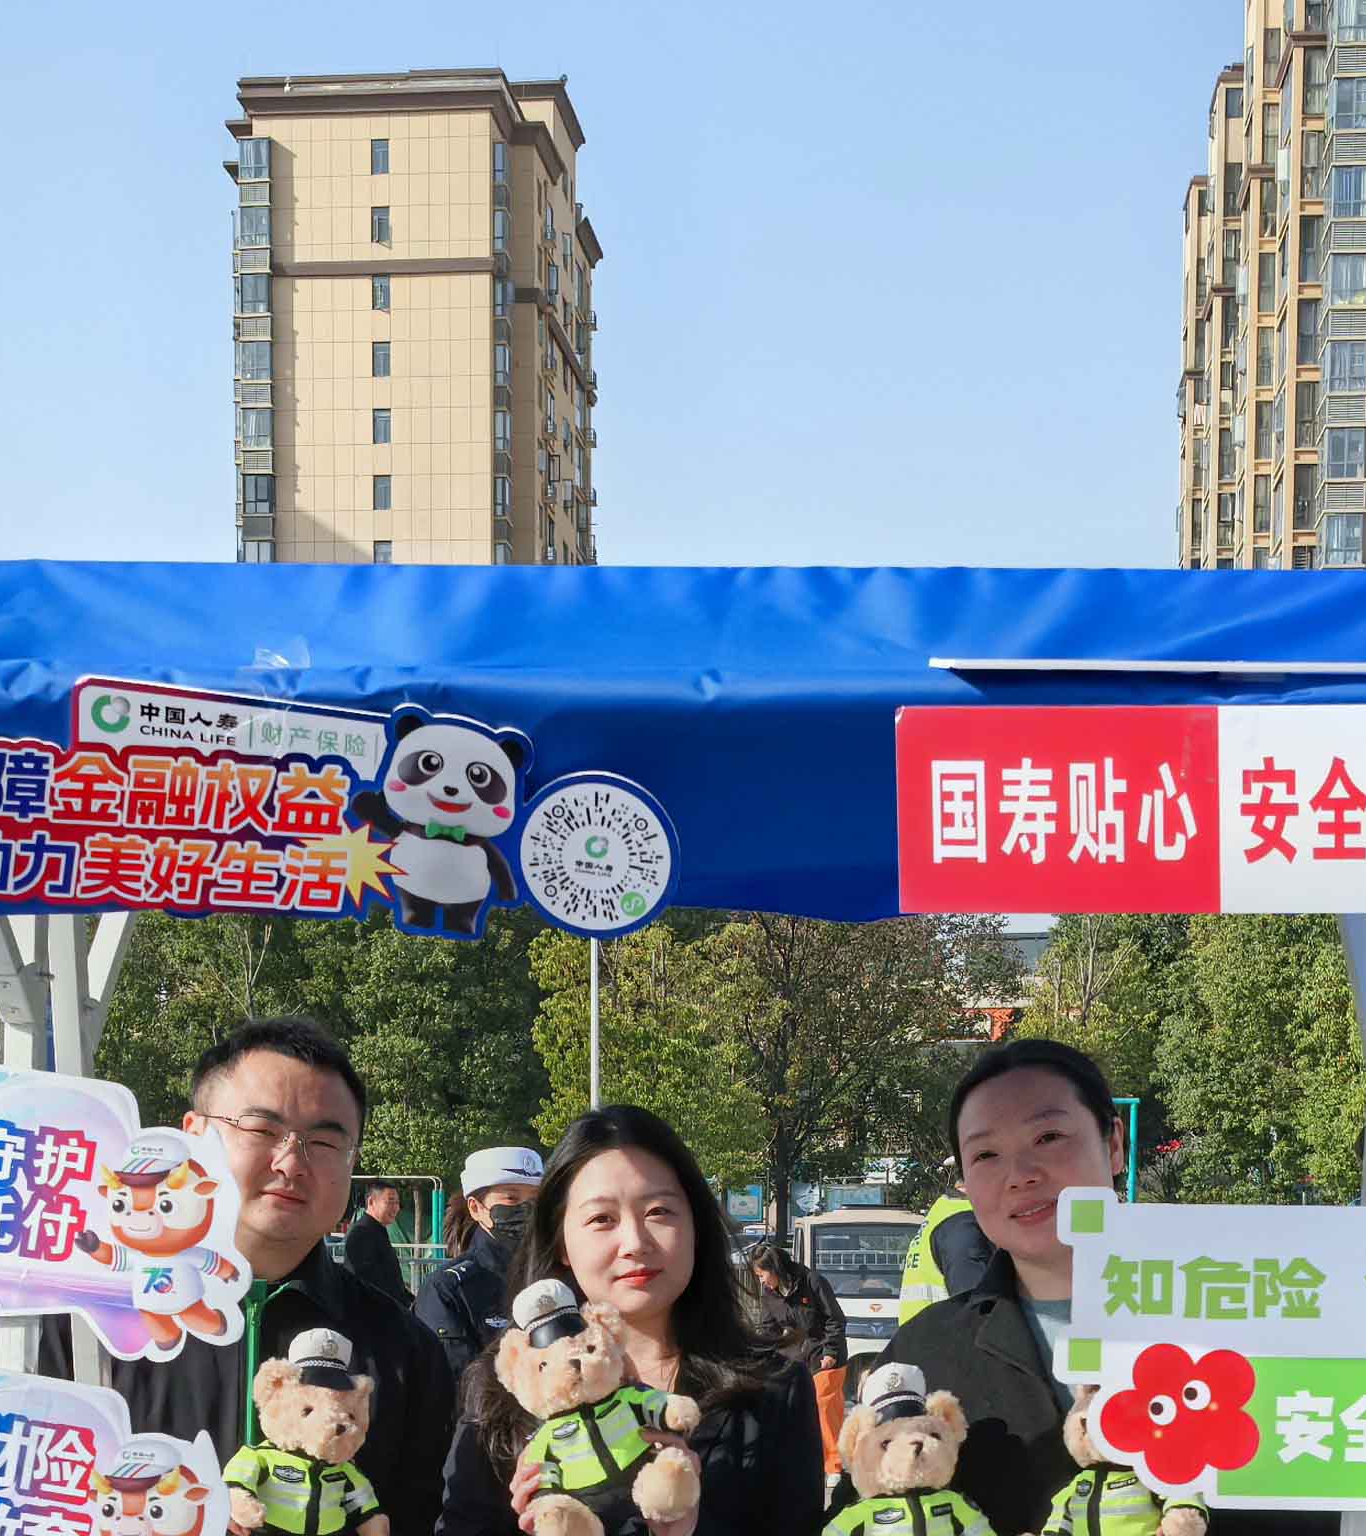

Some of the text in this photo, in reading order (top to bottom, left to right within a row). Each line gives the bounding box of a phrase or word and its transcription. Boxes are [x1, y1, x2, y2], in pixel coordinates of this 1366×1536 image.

[139, 703, 365, 757] 中国人寿 财产保险
[139, 725, 236, 746] CHINA LIFE
[931, 757, 1197, 864] 国寿贴心
[1101, 1254, 1326, 1320] 知危险
